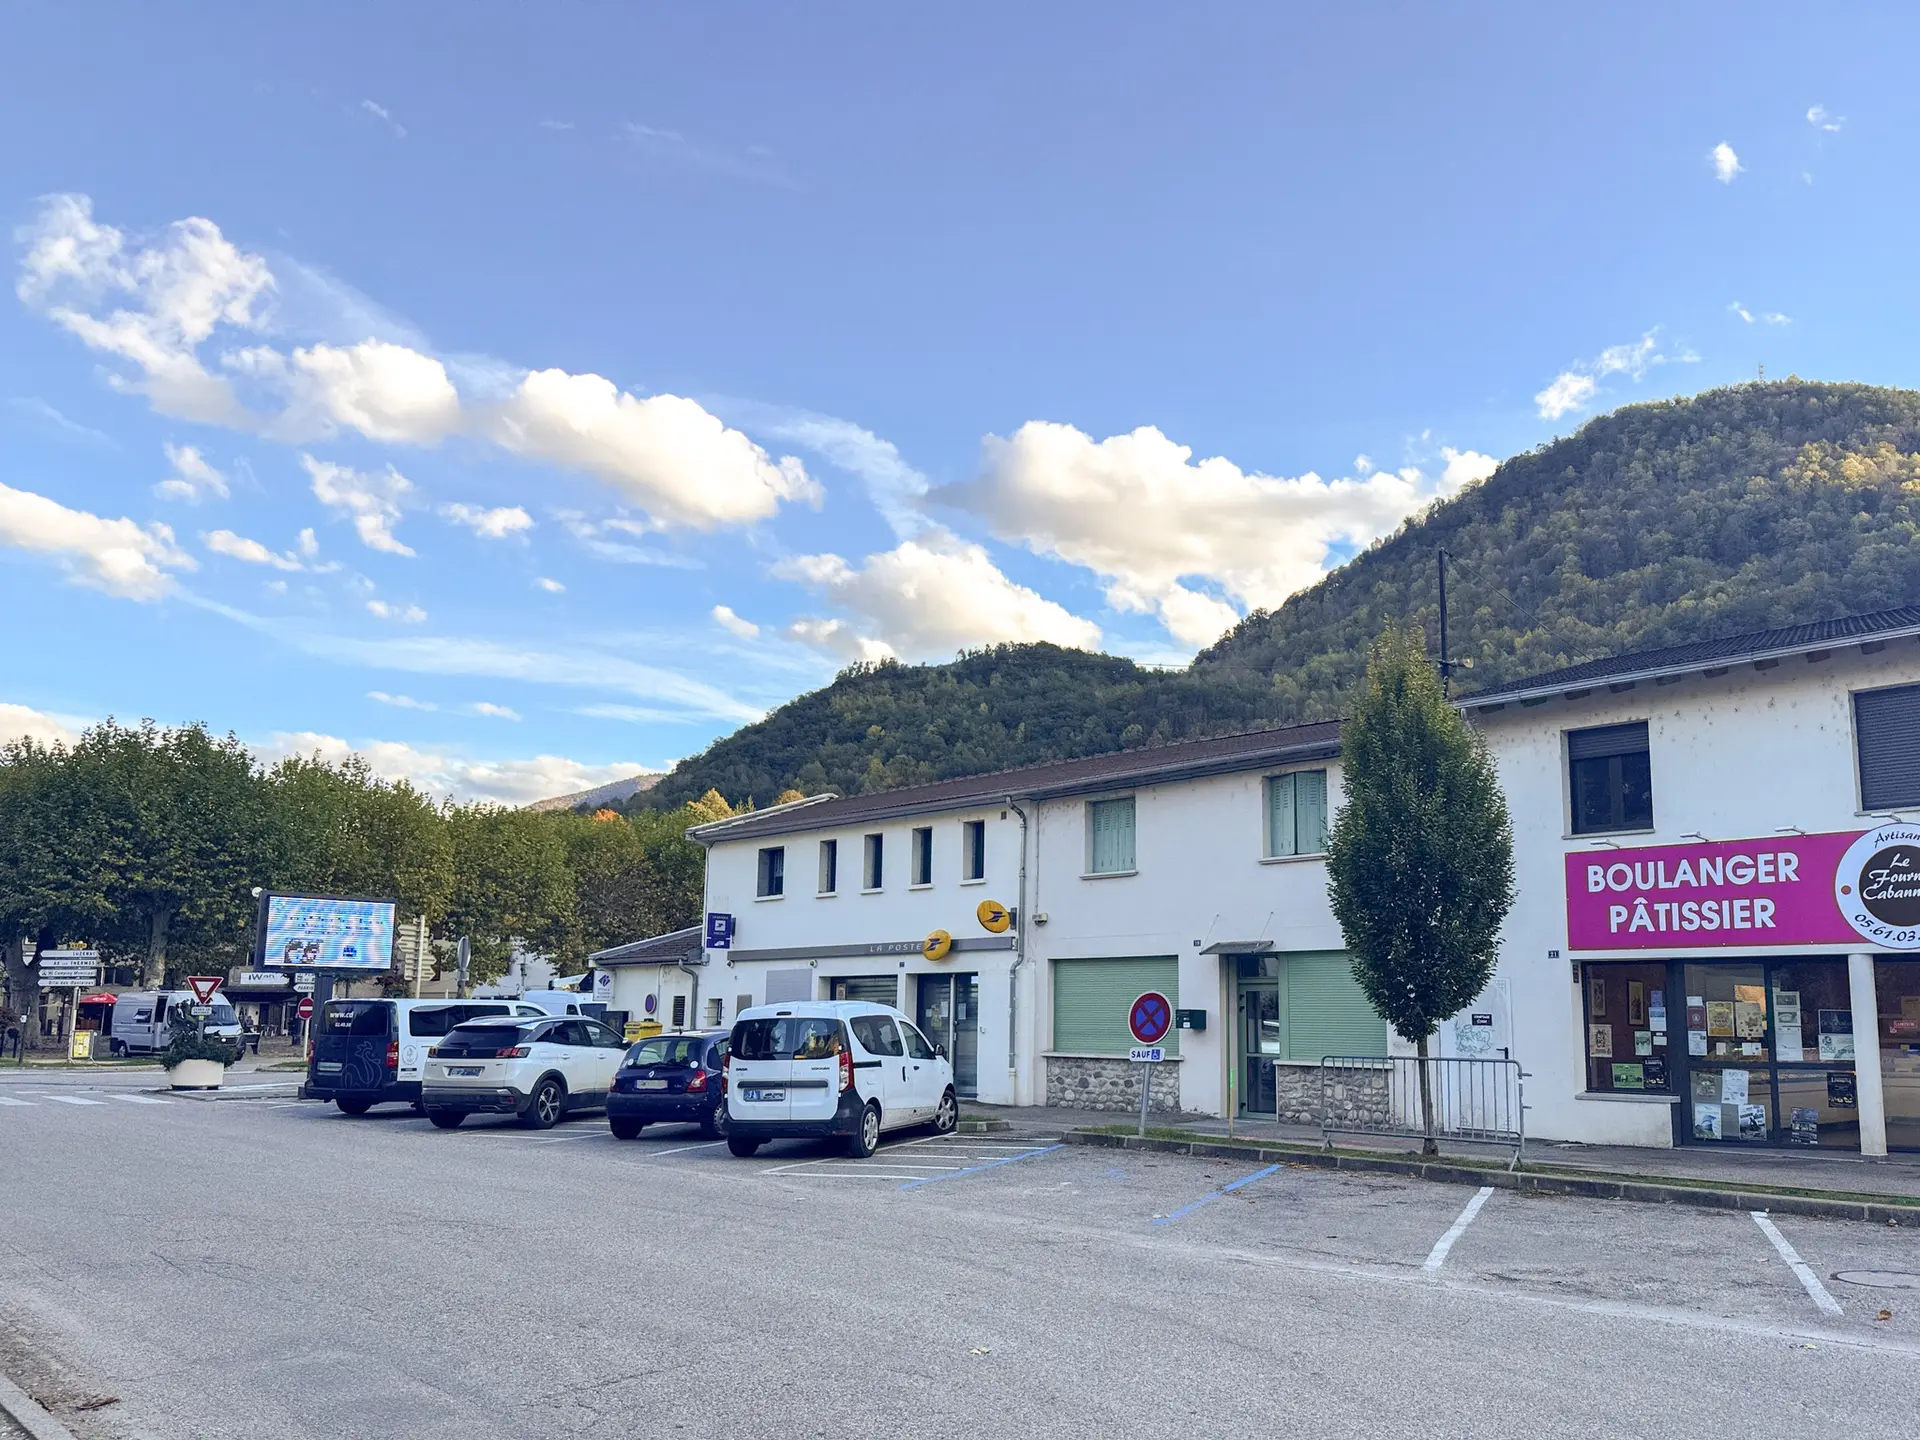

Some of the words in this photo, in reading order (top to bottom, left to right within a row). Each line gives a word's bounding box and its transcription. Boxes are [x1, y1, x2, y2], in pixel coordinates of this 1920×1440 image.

[1890, 853, 1910, 868] Le
[1587, 852, 1800, 893] BOULANGER
[1609, 897, 1776, 933] PÂTISSIER
[888, 943, 922, 952] POSTE
[1131, 1050, 1151, 1059] SAUF
